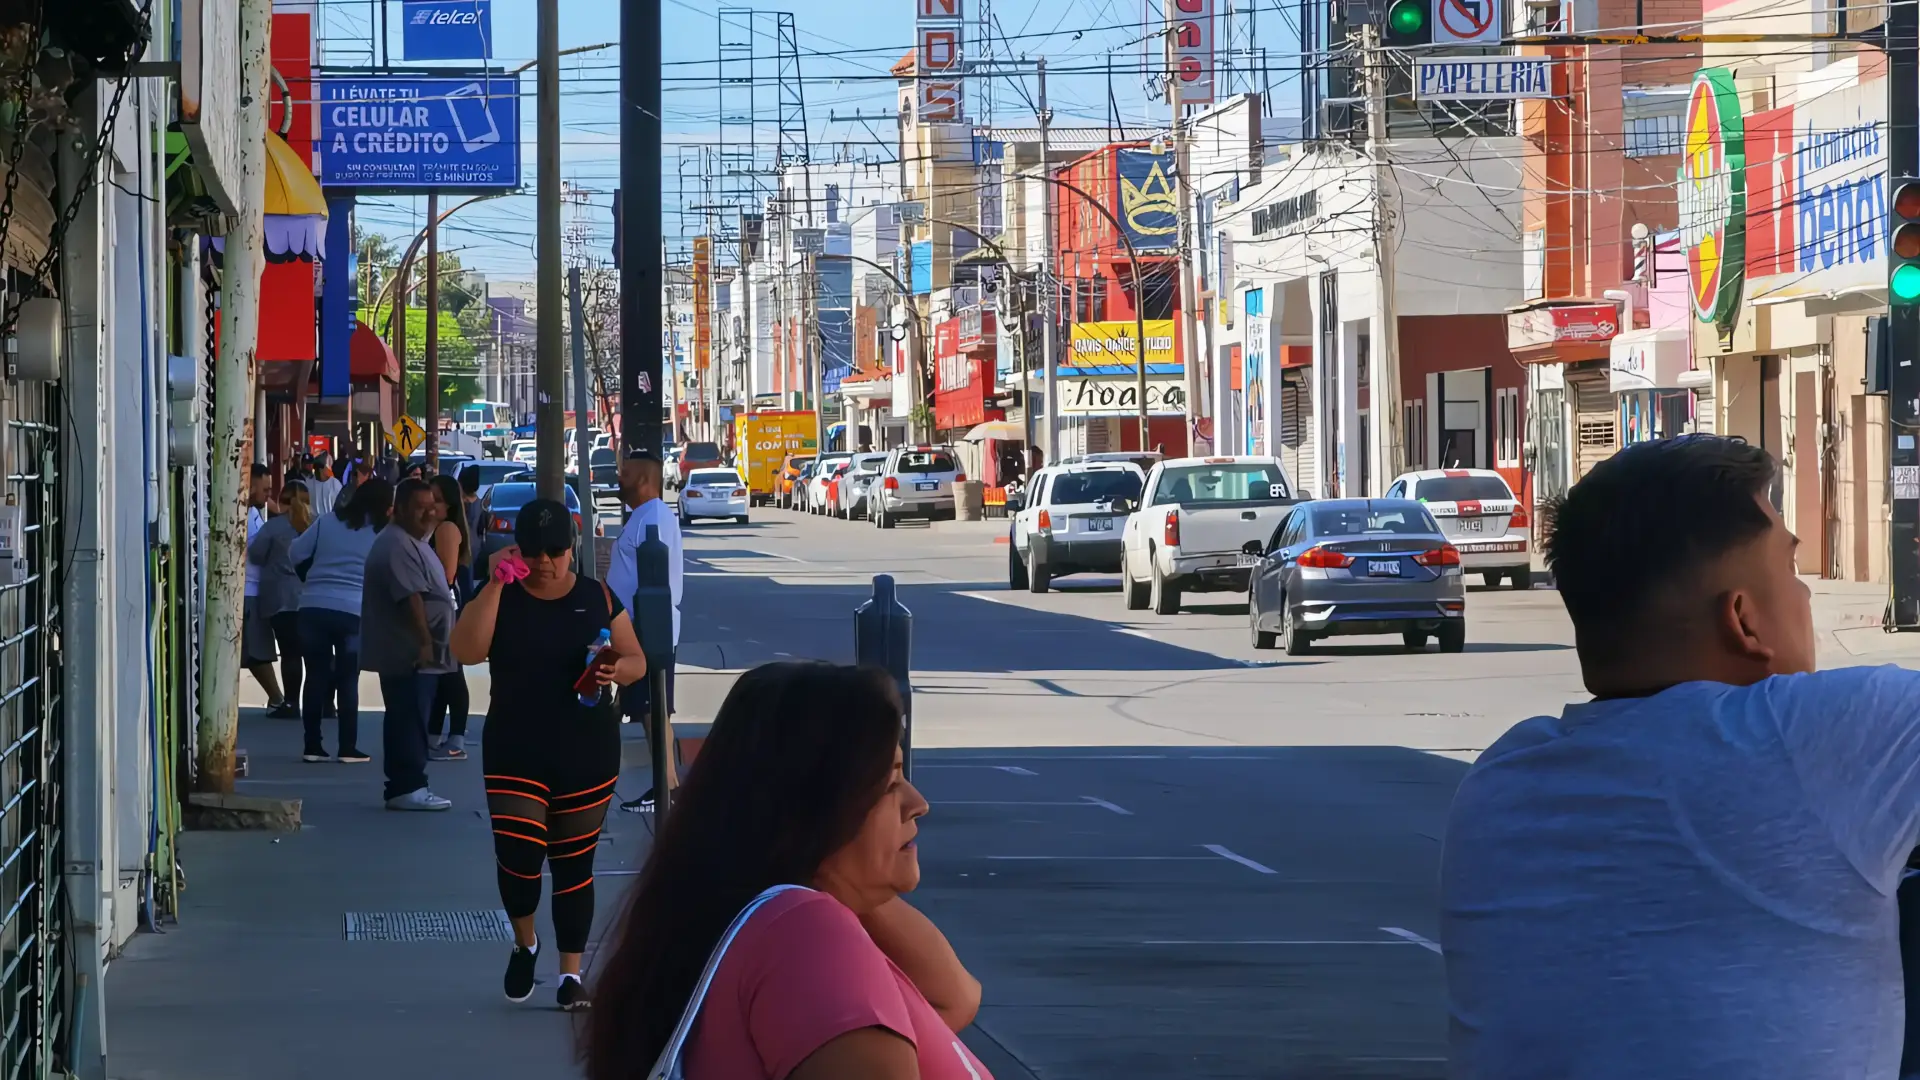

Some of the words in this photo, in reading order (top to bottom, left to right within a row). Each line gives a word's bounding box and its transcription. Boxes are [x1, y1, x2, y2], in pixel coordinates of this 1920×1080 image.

[429, 9, 484, 25] telcel
[1420, 62, 1547, 94] PAPELERIA
[399, 88, 419, 103] TU
[332, 106, 429, 127] CELULAR
[332, 132, 348, 153] A
[353, 127, 449, 154] CRÉDITO
[435, 172, 441, 181] 5
[444, 172, 493, 181] MINUTOS
